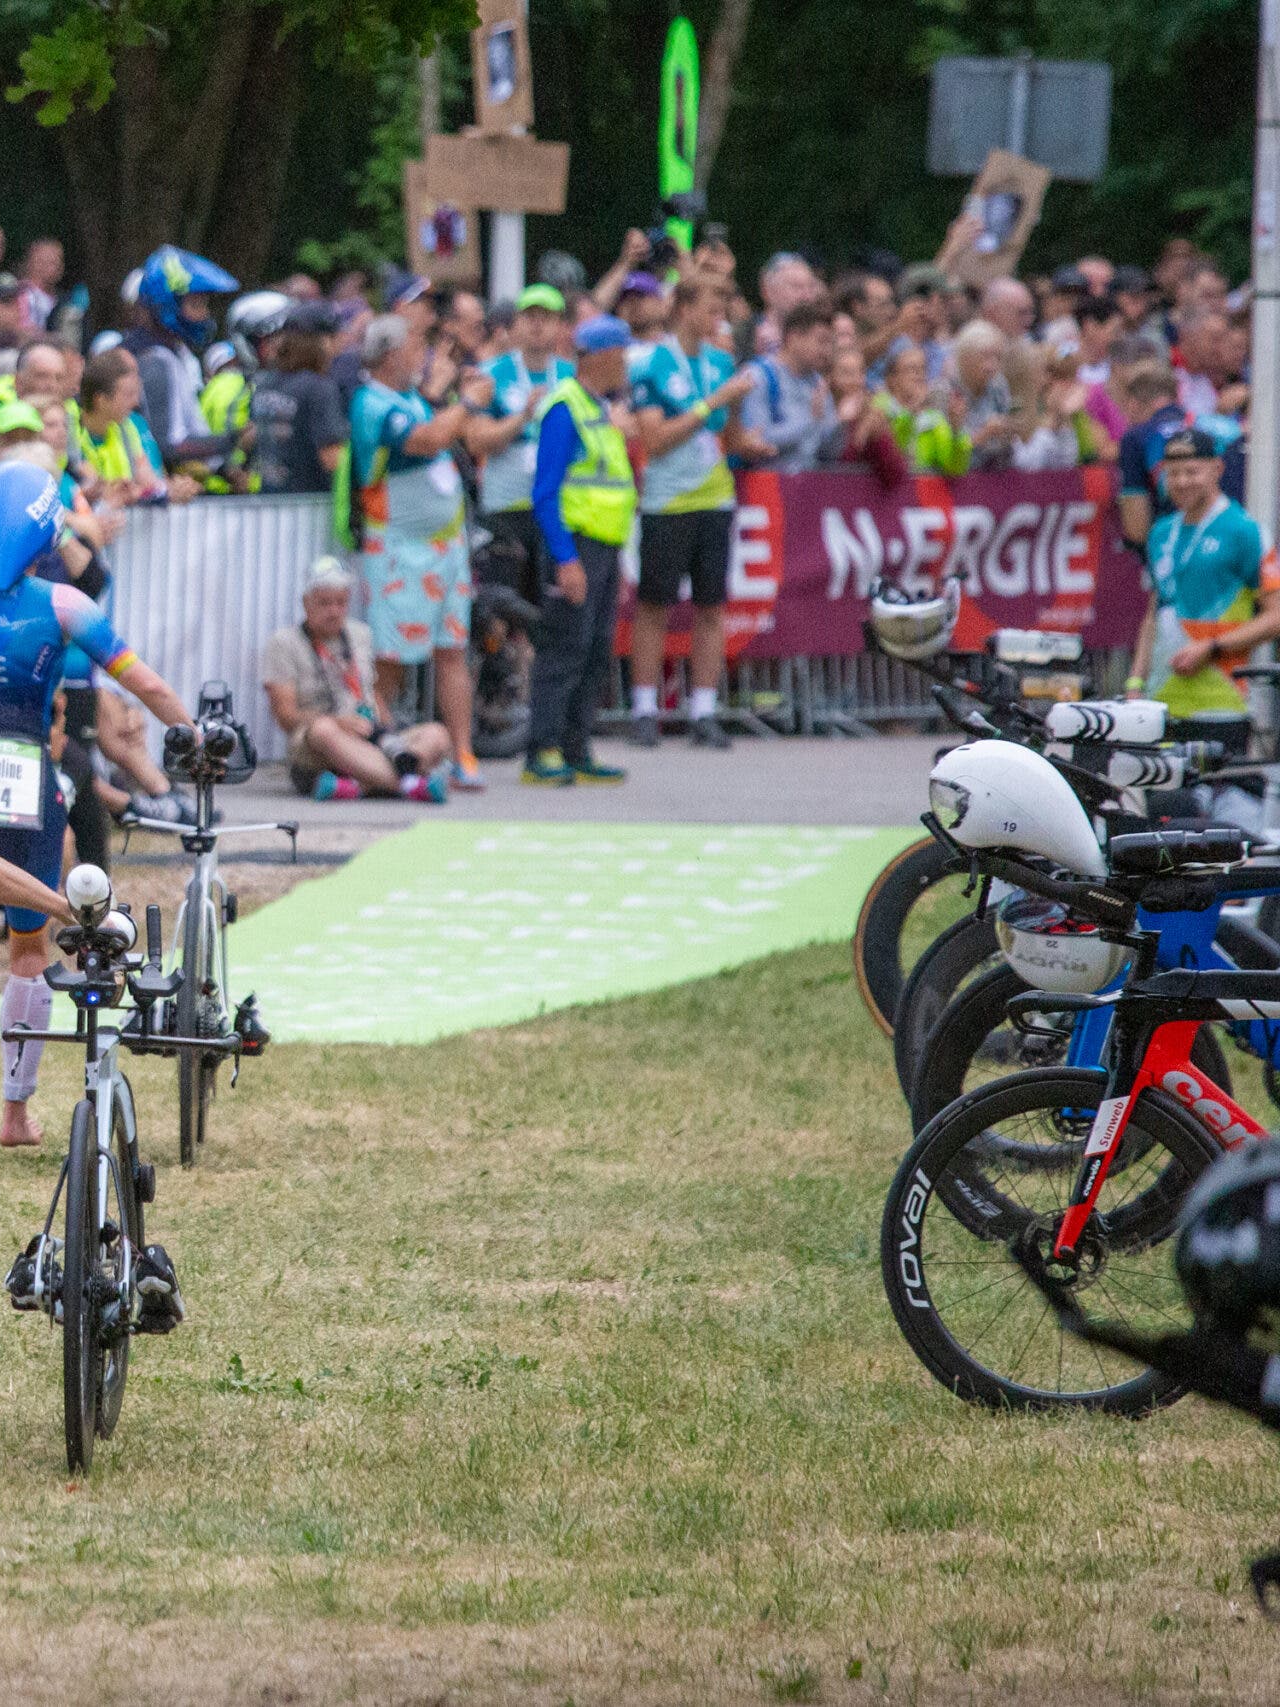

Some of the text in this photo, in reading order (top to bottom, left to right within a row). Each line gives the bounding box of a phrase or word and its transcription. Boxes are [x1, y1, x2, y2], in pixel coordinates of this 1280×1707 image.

[1002, 820, 1017, 833] 19
[1099, 1101, 1125, 1148] Sunweb
[900, 1167, 932, 1308] roval
